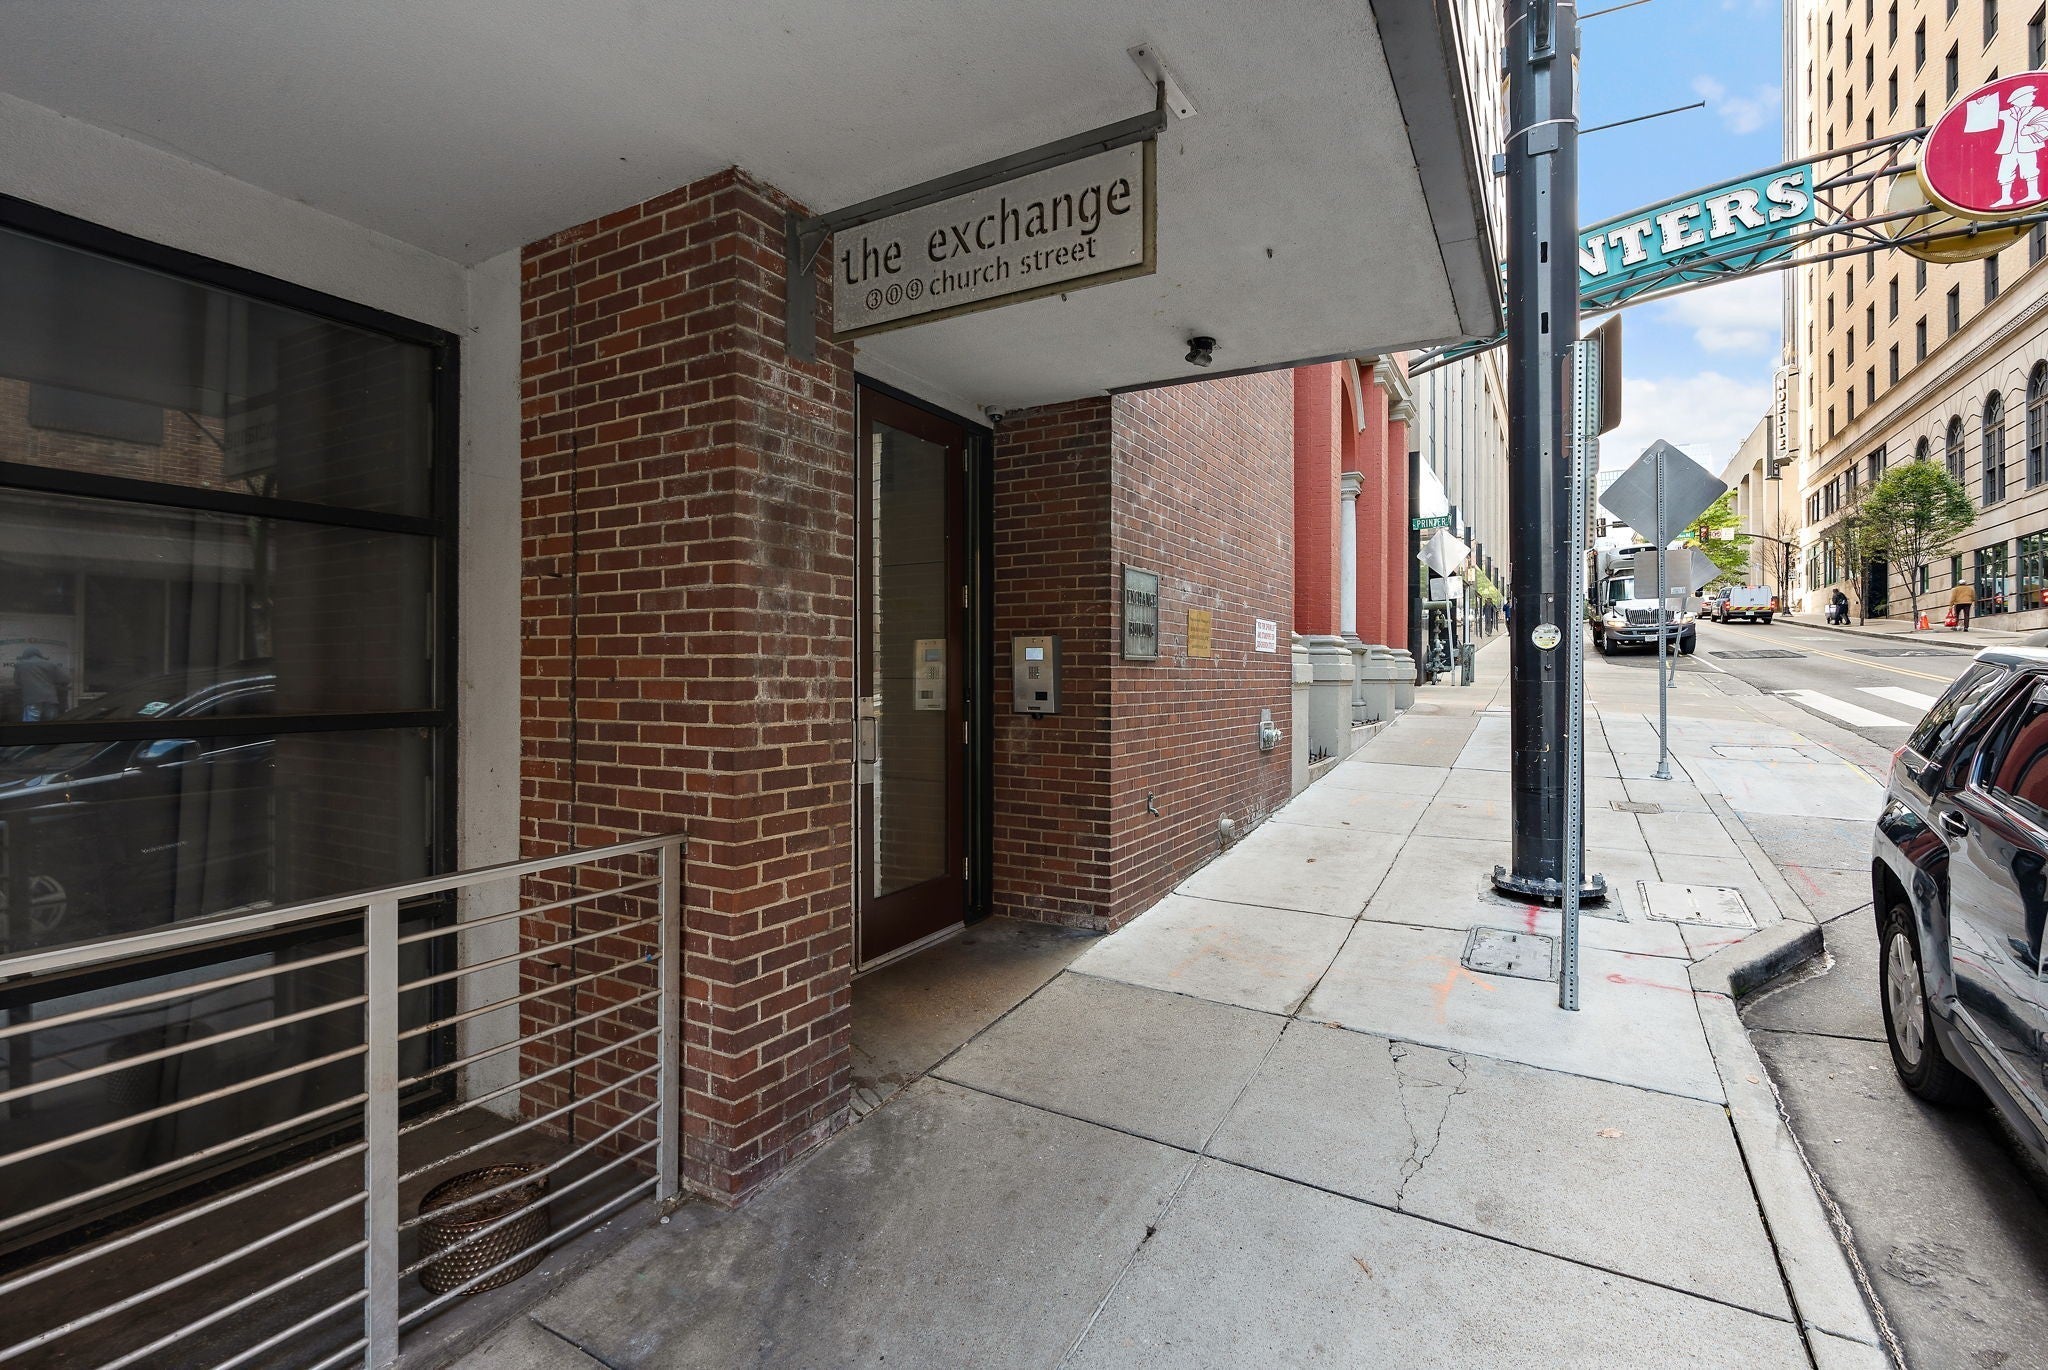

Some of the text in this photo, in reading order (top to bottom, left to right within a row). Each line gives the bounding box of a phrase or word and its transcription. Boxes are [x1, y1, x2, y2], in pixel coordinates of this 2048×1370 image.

[841, 177, 1131, 285] the exchange
[929, 256, 1009, 296] church
[1020, 236, 1097, 275] street
